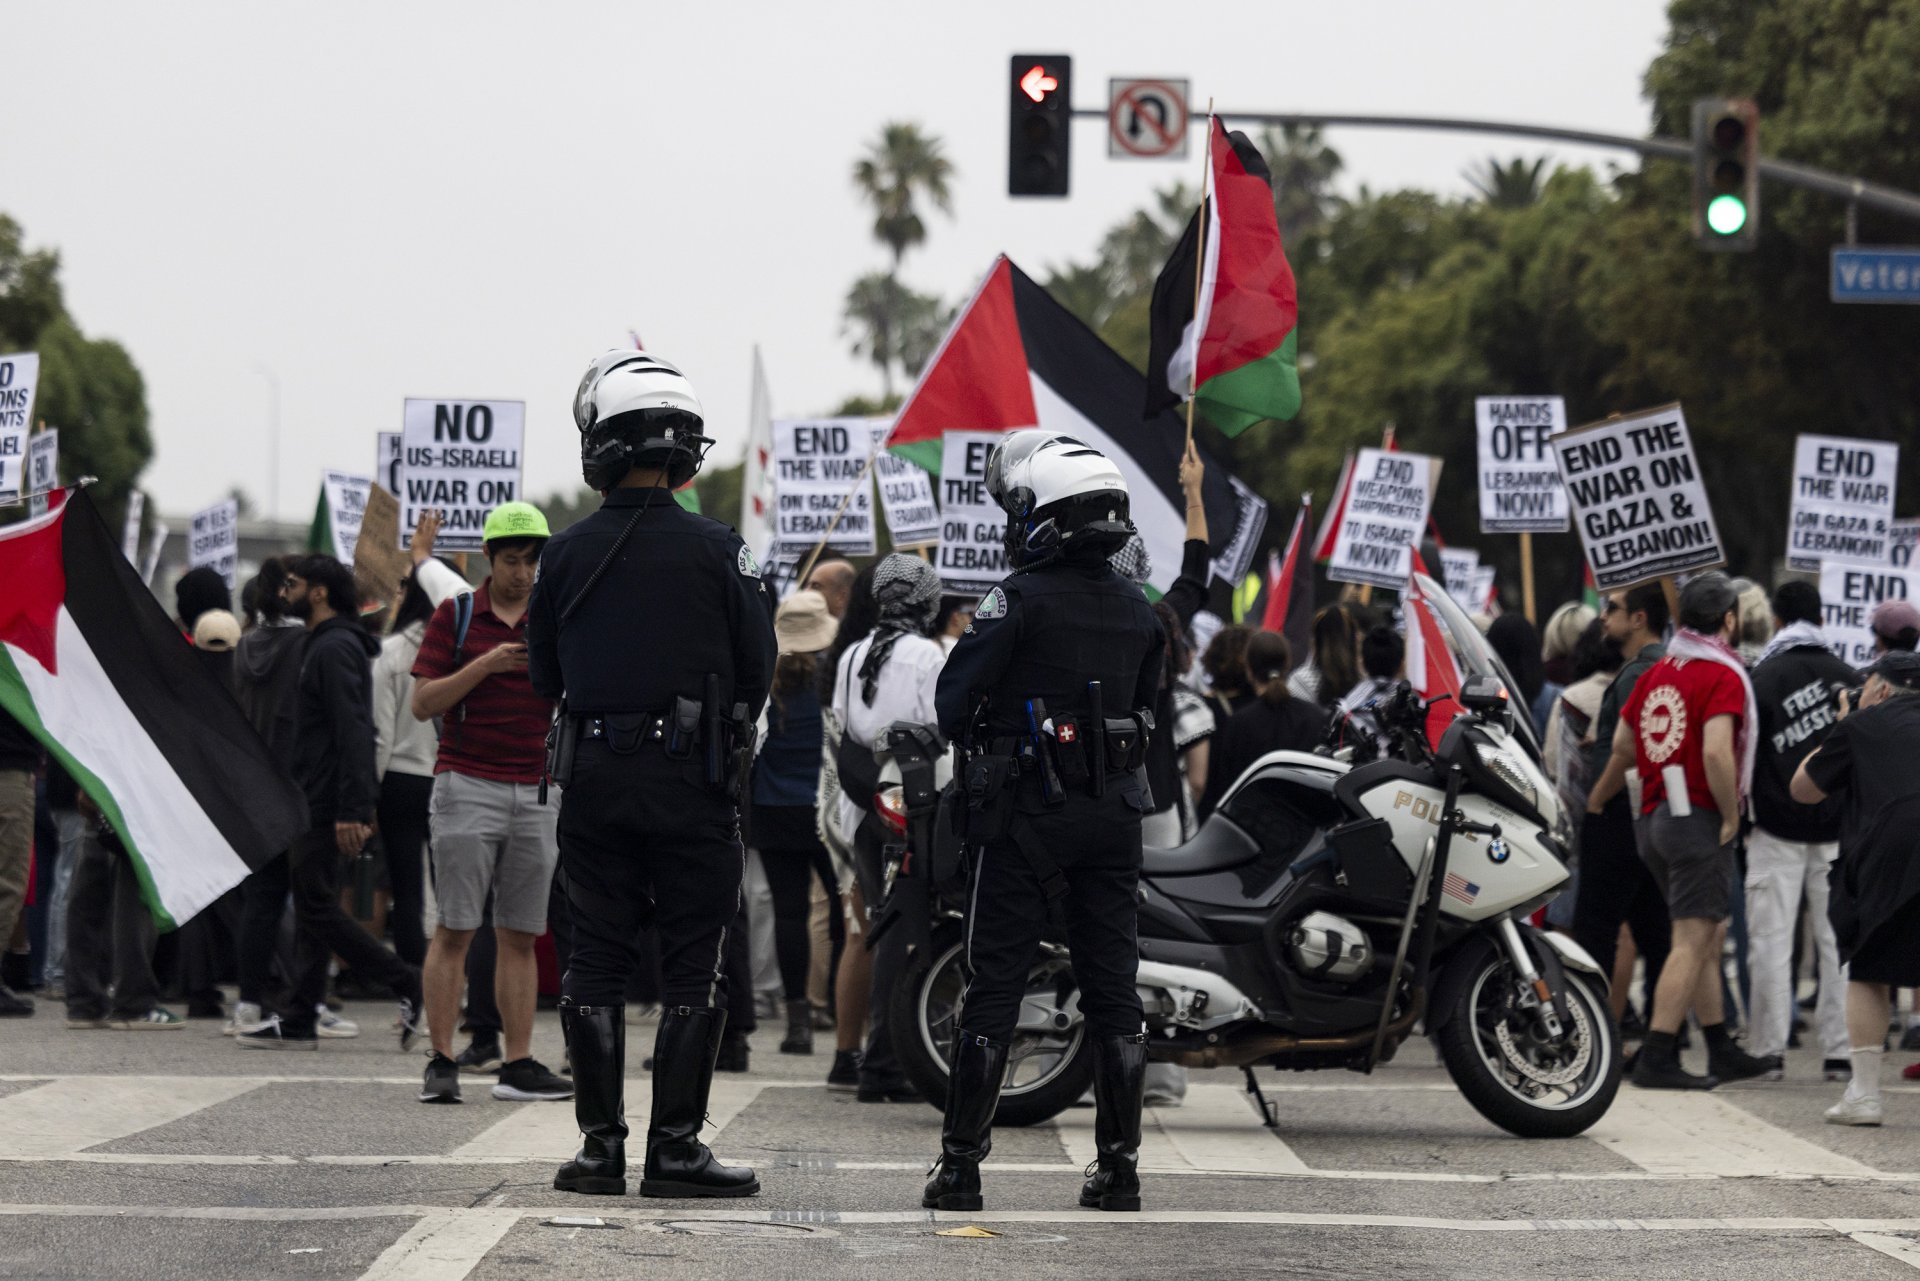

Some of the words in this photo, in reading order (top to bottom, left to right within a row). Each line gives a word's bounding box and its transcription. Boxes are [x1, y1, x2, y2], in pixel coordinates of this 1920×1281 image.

[434, 404, 493, 443] NO
[1490, 403, 1553, 425] HANDS
[794, 426, 849, 456] END
[1491, 425, 1554, 461] OFF
[1561, 436, 1621, 476] END
[1625, 421, 1685, 459] THE
[408, 448, 517, 468] US-ISRAELI
[779, 459, 817, 480] THE
[1374, 457, 1414, 485] END
[1815, 446, 1876, 478] END
[408, 480, 468, 504] WAR
[478, 482, 514, 504] ON
[945, 479, 986, 505] THE
[1354, 479, 1424, 506] WEAPONS
[1569, 465, 1645, 510] WAR
[1650, 453, 1695, 489] ON
[1799, 476, 1836, 500] THE
[1841, 480, 1889, 506] WAR
[780, 494, 804, 509] ON
[857, 495, 868, 509] &
[1495, 492, 1555, 518] NOW!
[1584, 498, 1665, 541] GAZA
[1670, 493, 1695, 519] &
[1796, 511, 1819, 529] ON
[1824, 514, 1869, 533] GAZA
[943, 522, 967, 542] ON
[974, 523, 1006, 543] GAZ
[1589, 520, 1713, 570] LEBANON!
[1793, 530, 1885, 559] LEBANON!
[1844, 571, 1908, 603] END
[1822, 604, 1866, 628] THE
[1781, 678, 1830, 719] FREE
